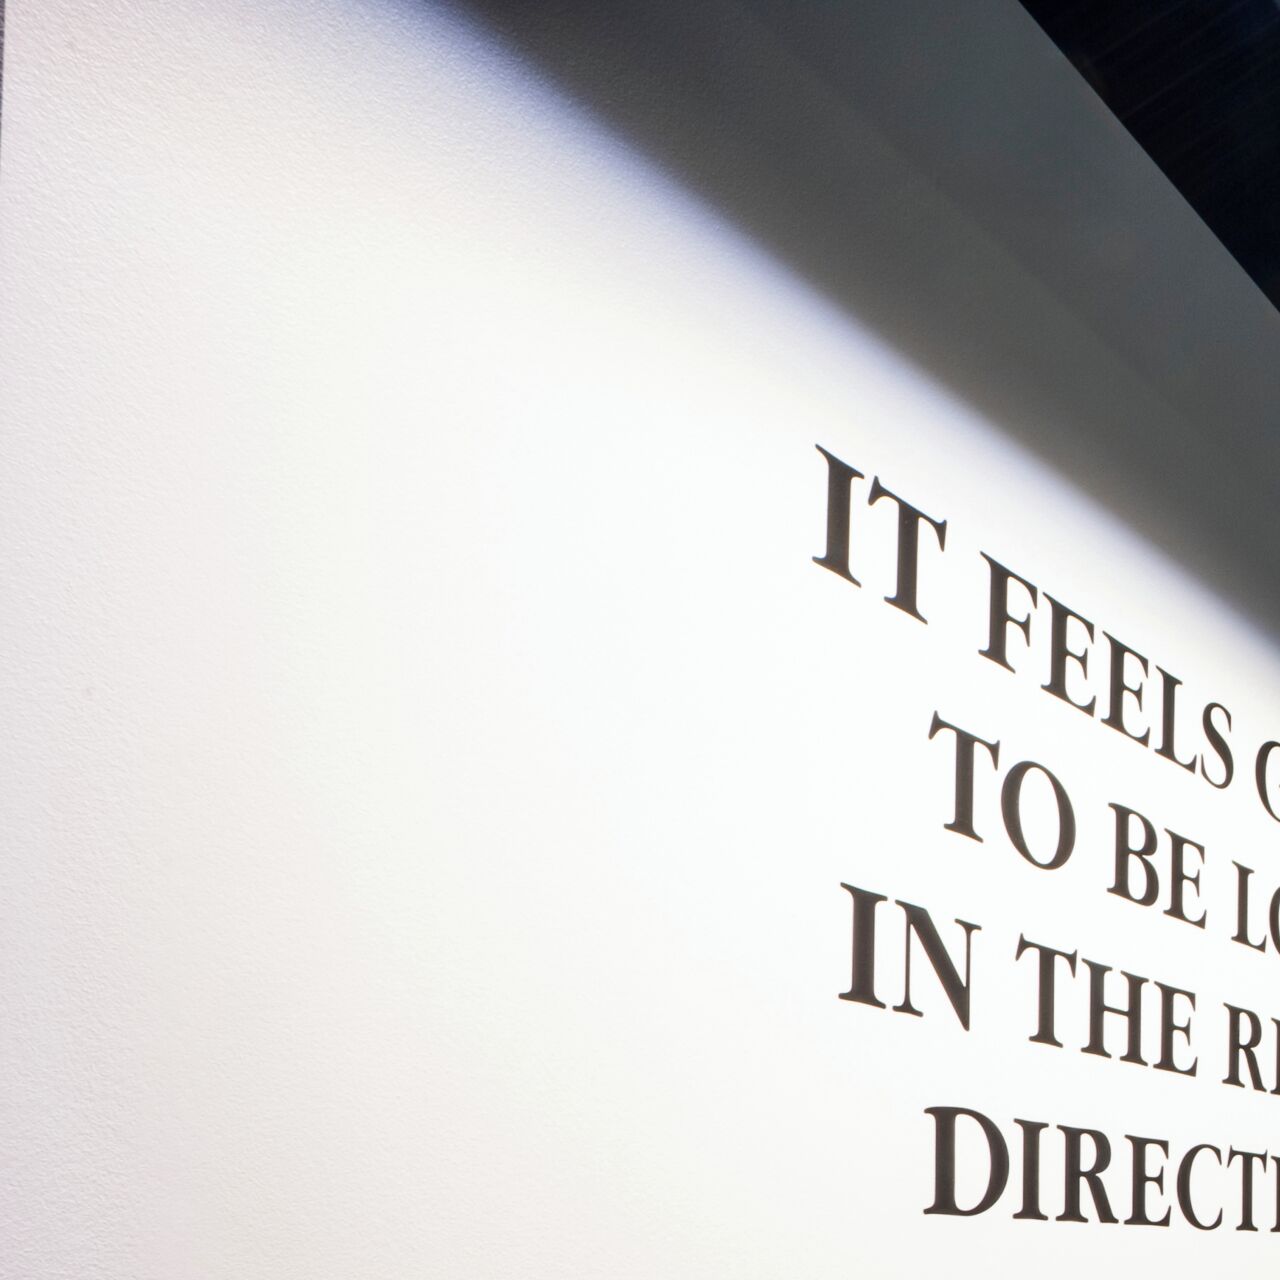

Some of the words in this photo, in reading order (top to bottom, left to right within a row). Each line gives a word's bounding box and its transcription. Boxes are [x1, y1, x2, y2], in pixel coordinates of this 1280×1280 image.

[812, 444, 947, 624] IT
[978, 551, 1234, 789] FEELS
[929, 711, 1076, 870] TO
[1107, 803, 1207, 929] BE
[838, 882, 982, 1031] IN
[1015, 934, 1198, 1077] THE
